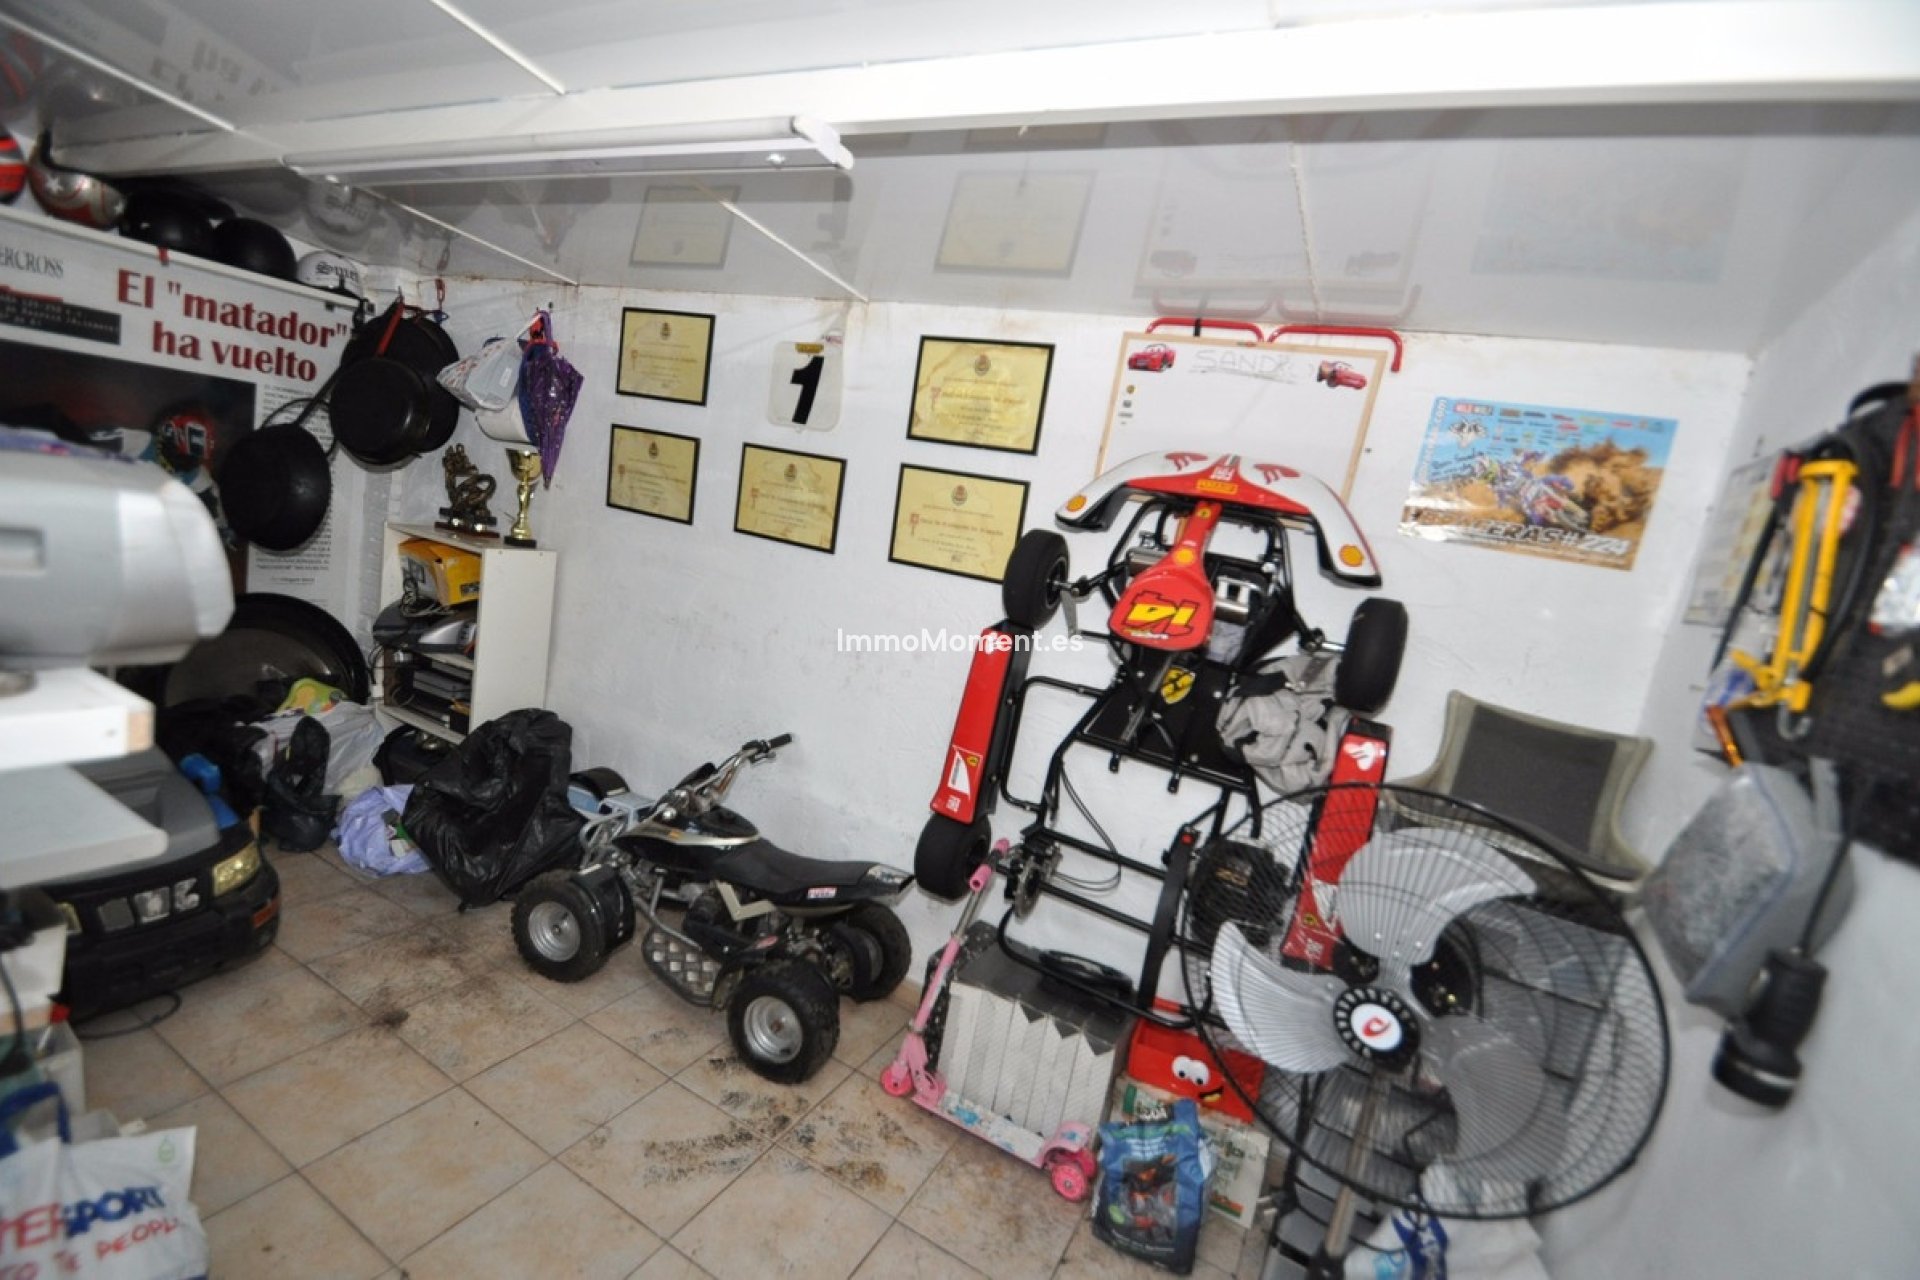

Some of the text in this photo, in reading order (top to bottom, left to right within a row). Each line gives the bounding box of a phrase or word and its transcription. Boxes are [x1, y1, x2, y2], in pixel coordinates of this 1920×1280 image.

[118, 269, 154, 309] El
[168, 280, 348, 348] "matador"
[153, 321, 317, 382] ha vuelto
[790, 355, 825, 425] 1
